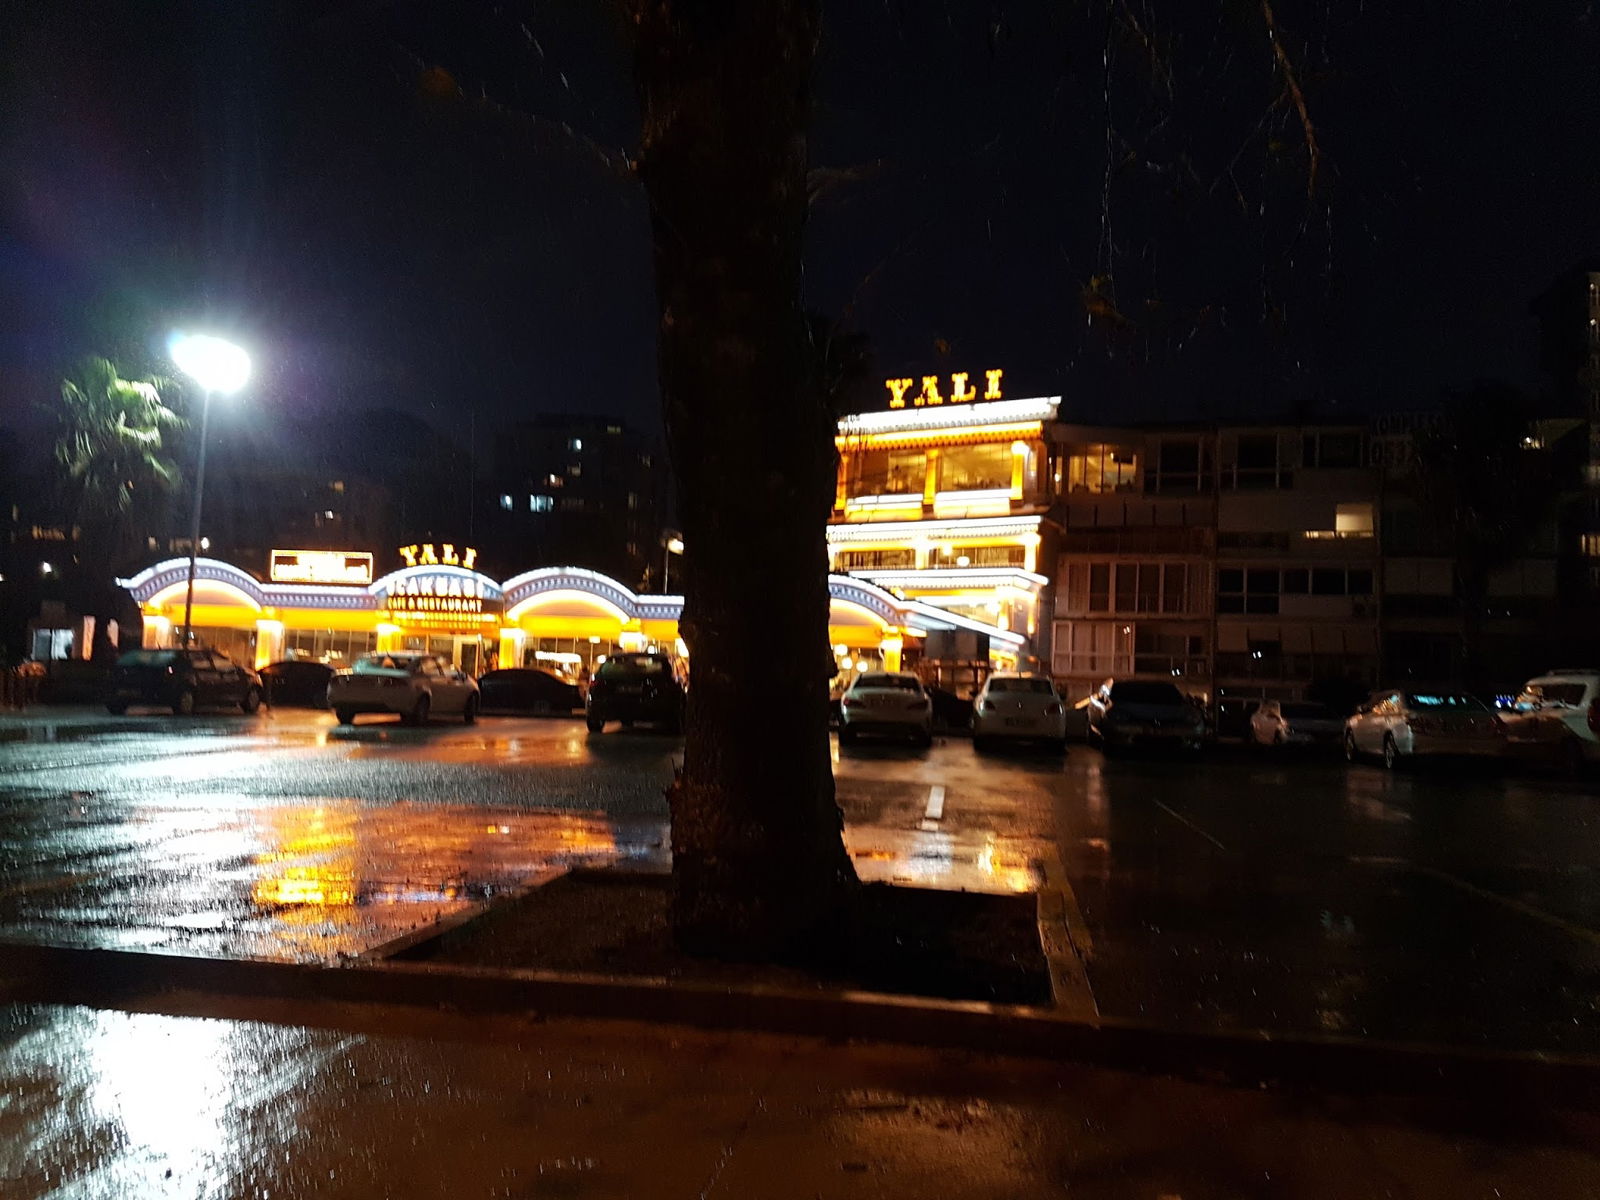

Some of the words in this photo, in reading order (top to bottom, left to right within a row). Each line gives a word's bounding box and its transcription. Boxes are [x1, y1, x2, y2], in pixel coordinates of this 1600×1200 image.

[886, 369, 1003, 408] YALI
[399, 543, 477, 569] YALI
[417, 597, 482, 613] RESTAURANT
